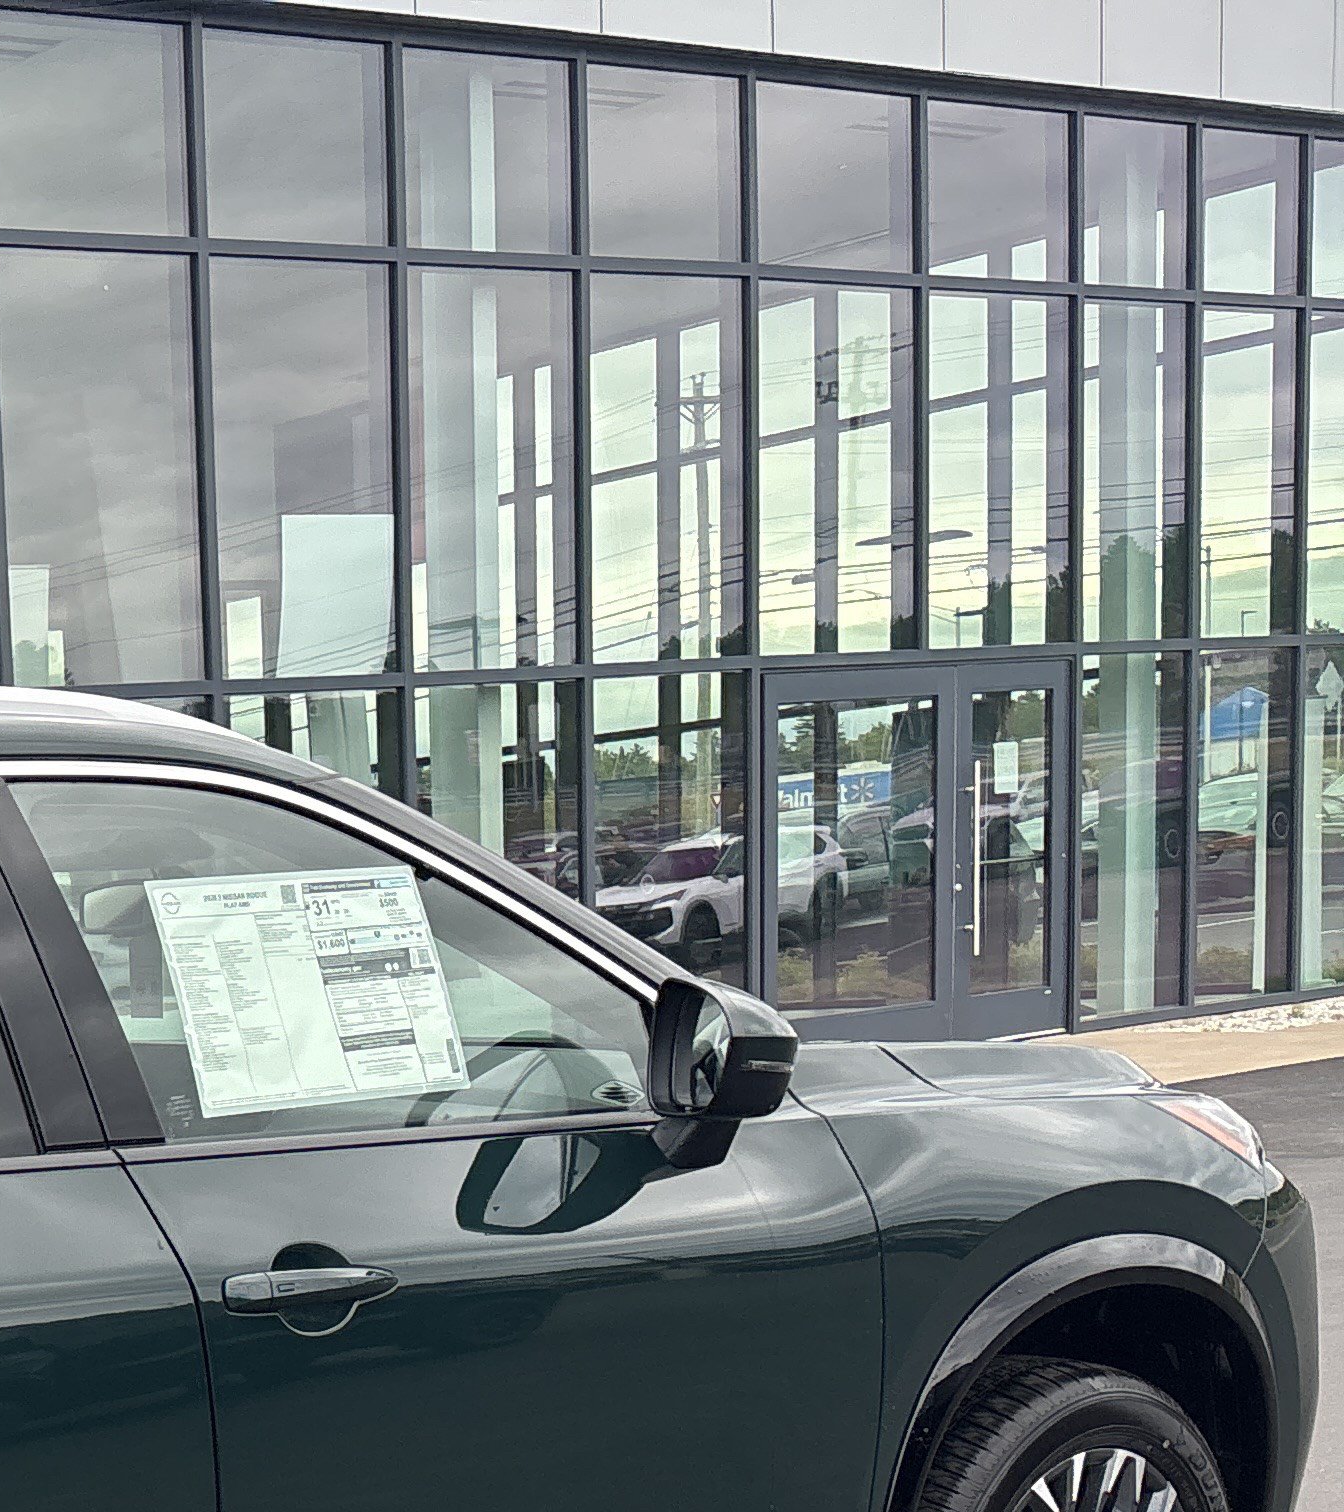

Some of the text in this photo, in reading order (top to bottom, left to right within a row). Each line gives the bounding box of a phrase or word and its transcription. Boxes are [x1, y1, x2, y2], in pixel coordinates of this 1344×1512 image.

[778, 783, 848, 809] almt
[311, 898, 331, 917] 31
[379, 897, 399, 909] $500
